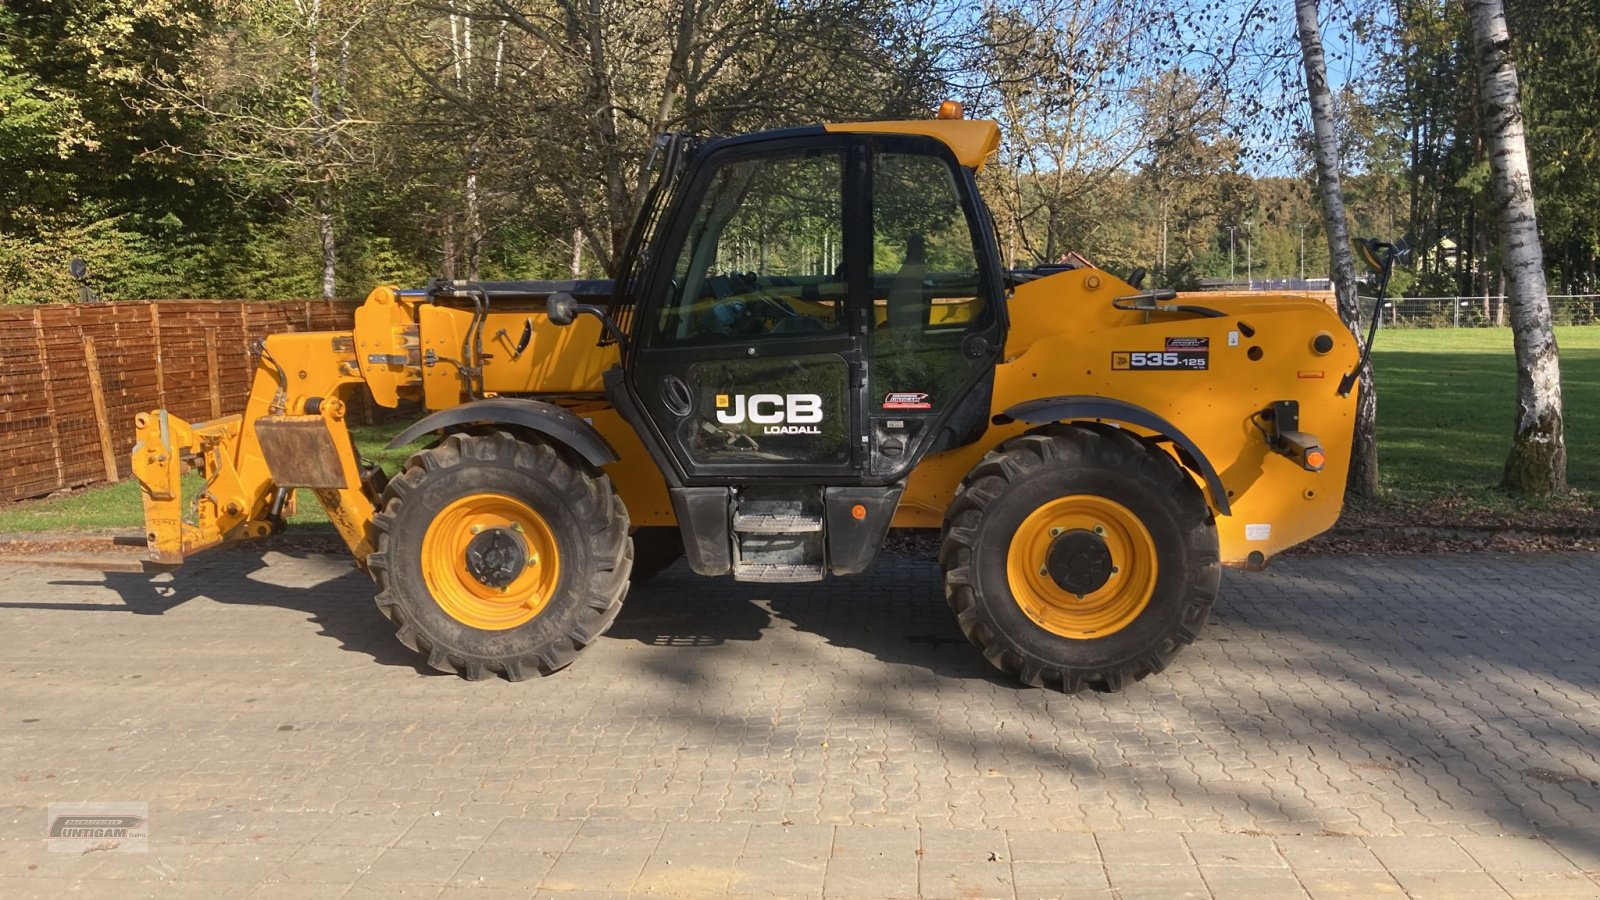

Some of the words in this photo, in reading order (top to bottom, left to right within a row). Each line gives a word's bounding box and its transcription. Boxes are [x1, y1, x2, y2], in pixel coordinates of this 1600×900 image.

[1131, 352, 1206, 366] 535-125
[716, 394, 823, 424] JCB
[763, 426, 822, 434] LOADALL
